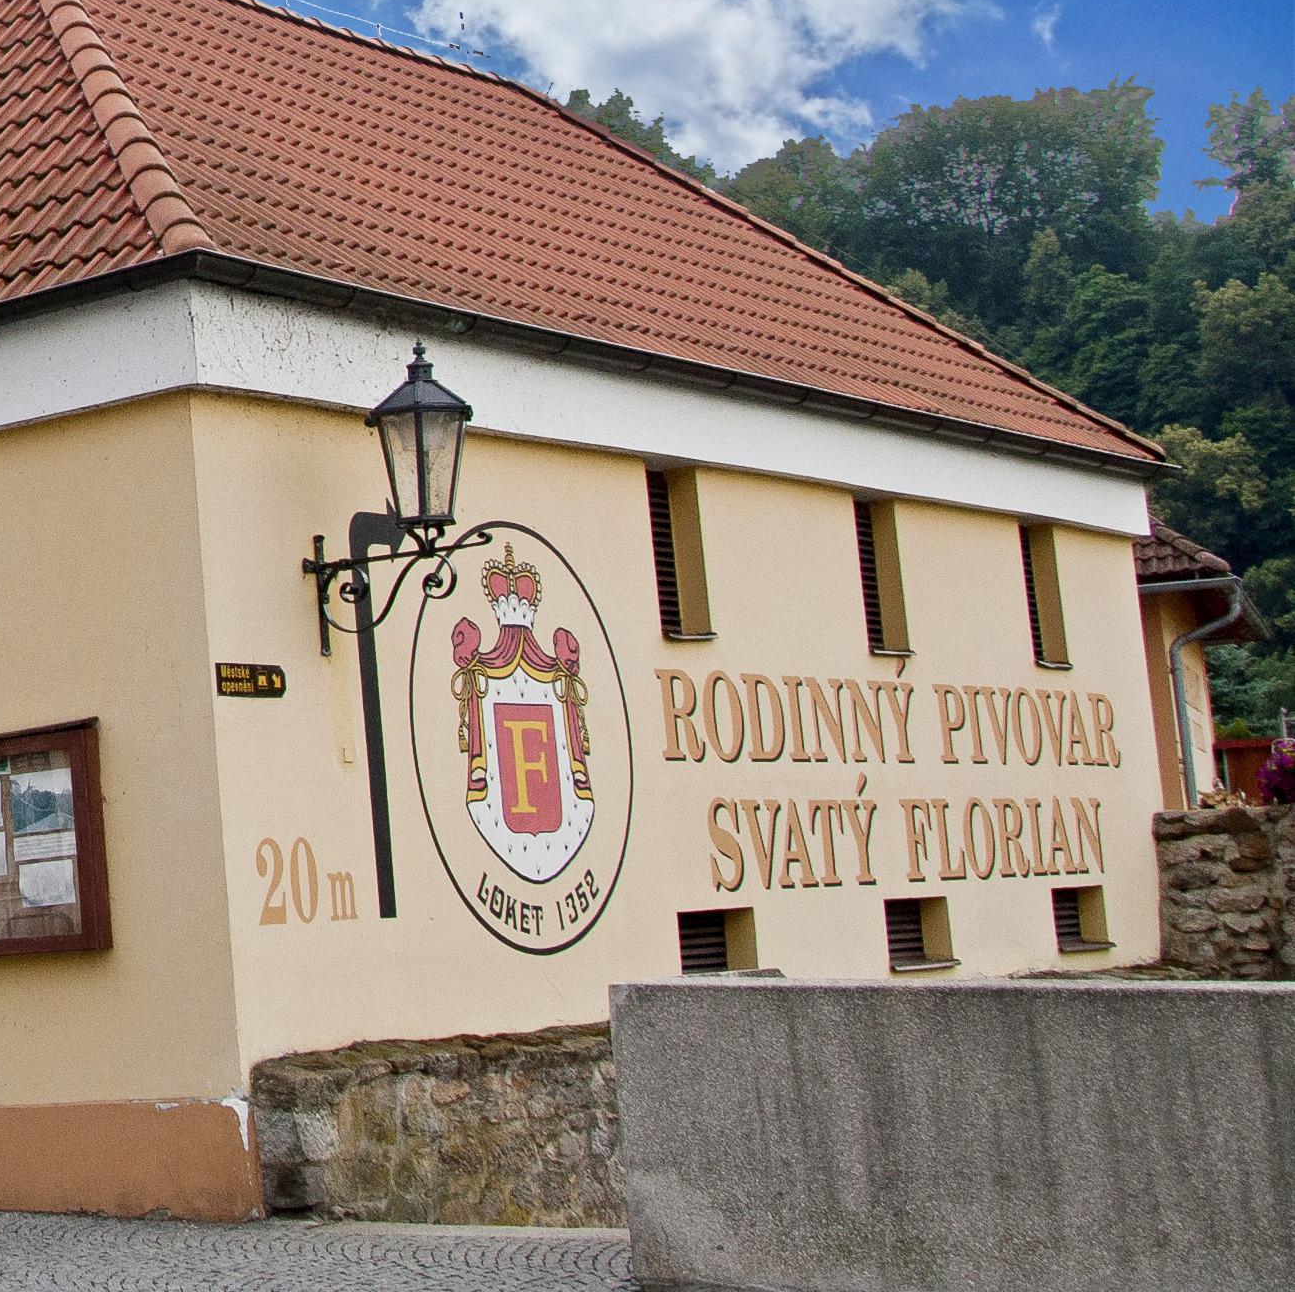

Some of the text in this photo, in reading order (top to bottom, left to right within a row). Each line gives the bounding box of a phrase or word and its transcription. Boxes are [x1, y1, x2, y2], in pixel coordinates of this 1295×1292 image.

[654, 658, 1121, 768] RODINNÝ PIVOVAR
[503, 720, 549, 814] F
[707, 771, 1106, 892] SVATÝ FLORIAN
[256, 836, 358, 926] 20 m
[477, 868, 600, 936] LOKET 1352
